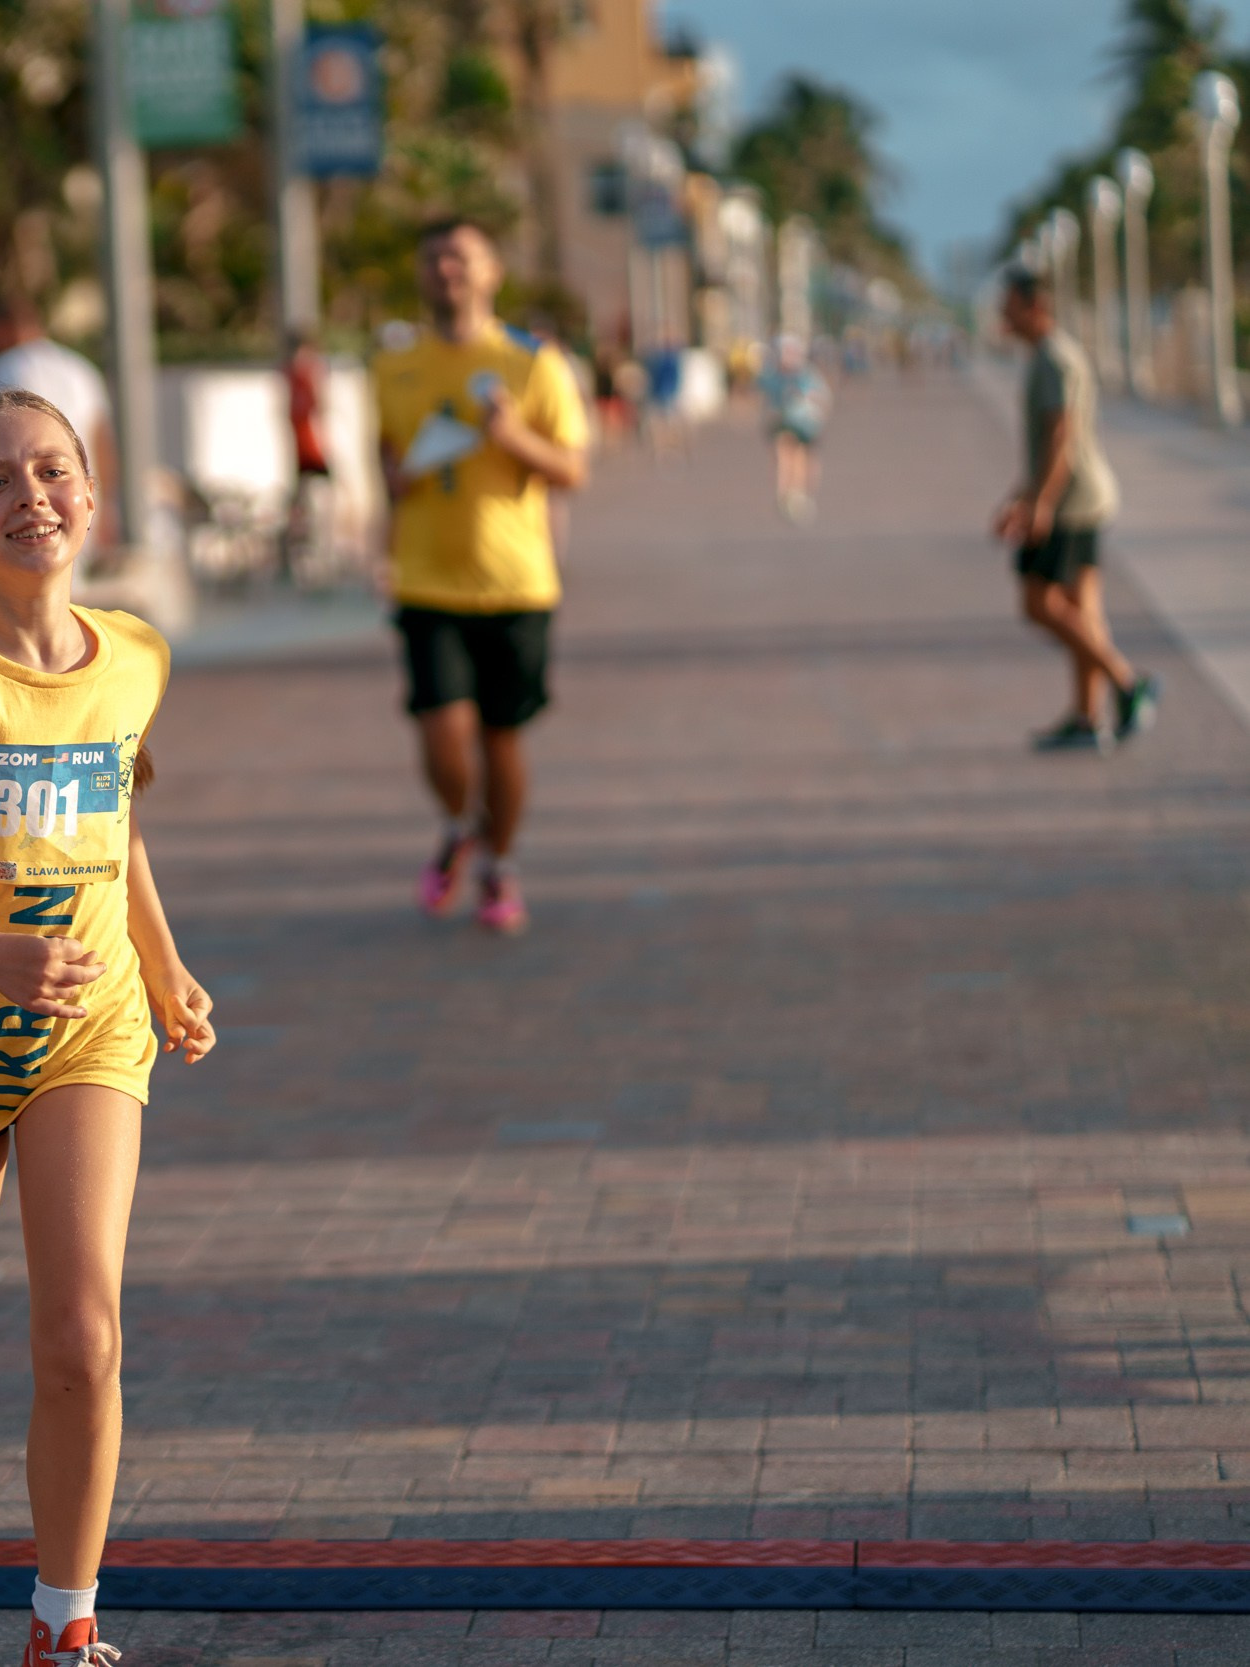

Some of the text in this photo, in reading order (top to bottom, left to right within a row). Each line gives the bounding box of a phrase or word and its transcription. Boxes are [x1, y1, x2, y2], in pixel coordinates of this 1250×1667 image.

[72, 751, 104, 765] RUN
[25, 865, 111, 876] SLAVA UKRAINI!
